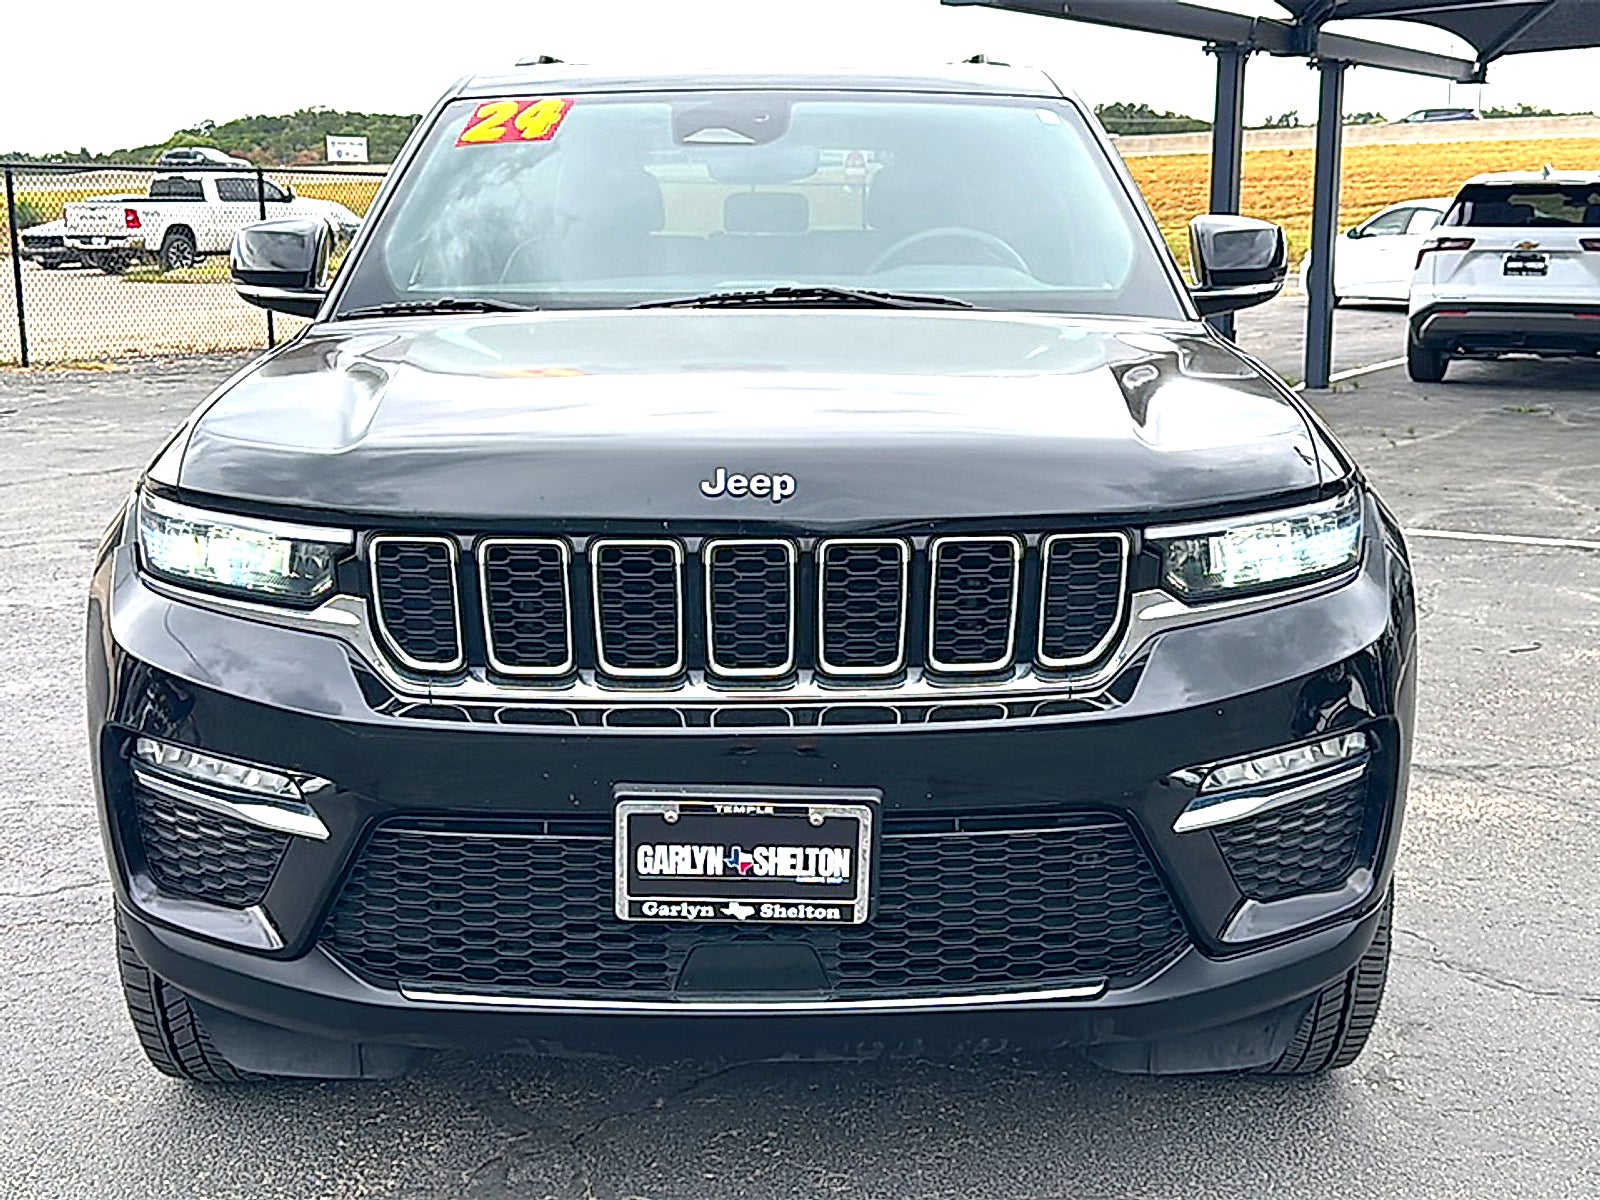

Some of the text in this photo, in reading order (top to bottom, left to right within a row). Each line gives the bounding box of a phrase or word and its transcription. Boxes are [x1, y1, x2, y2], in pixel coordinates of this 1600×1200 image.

[460, 99, 566, 142] 24
[700, 467, 797, 503] Jeep
[713, 804, 775, 815] TEMPLE
[636, 845, 850, 878] GARLYN SHELTON
[641, 901, 841, 920] Garlyn Shelton
